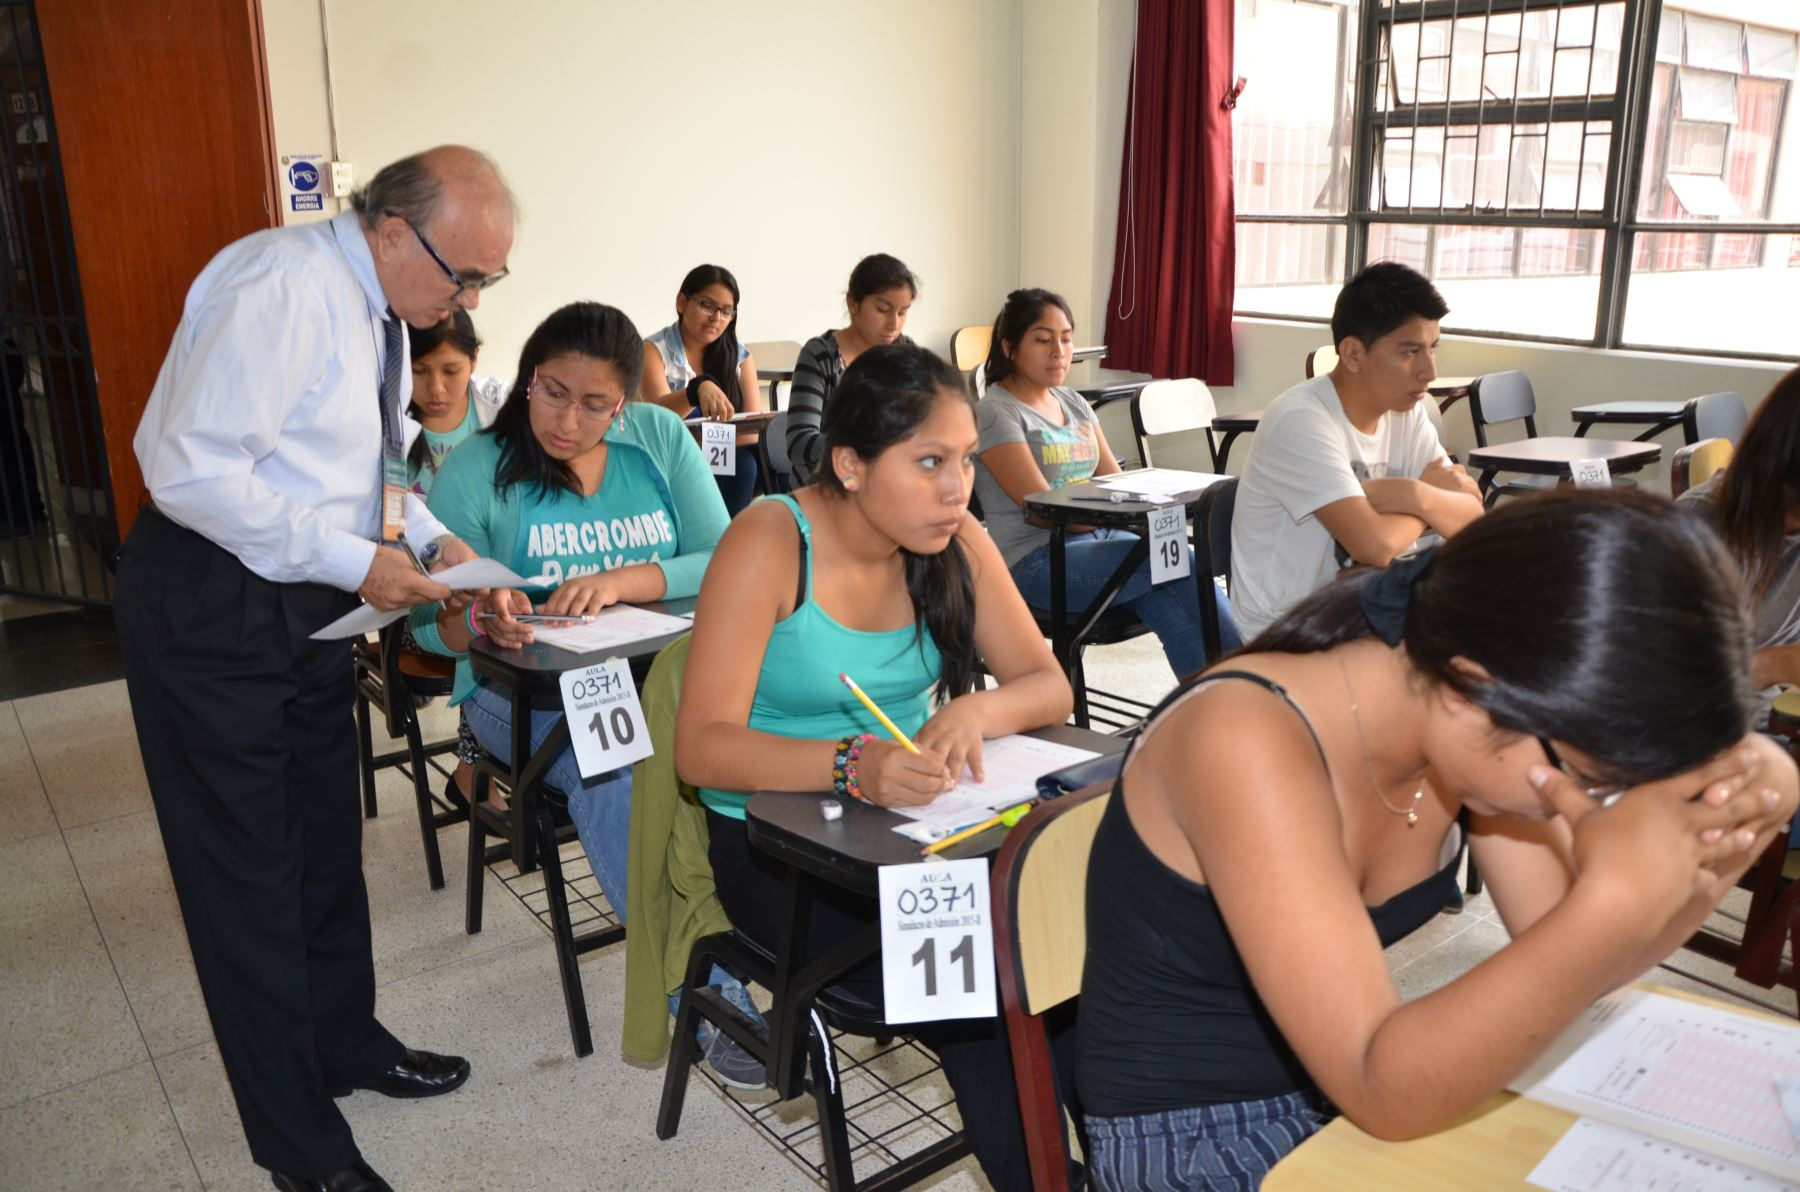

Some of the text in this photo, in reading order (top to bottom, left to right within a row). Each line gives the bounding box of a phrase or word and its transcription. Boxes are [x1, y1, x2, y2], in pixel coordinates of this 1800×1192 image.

[707, 429, 730, 440] 0371
[710, 446, 727, 467] 21
[527, 509, 673, 558] ABERCROMBIE
[1154, 514, 1180, 532] 0371
[1160, 539, 1180, 568] 19
[572, 671, 622, 700] 0371
[585, 666, 606, 677] AULA
[588, 706, 635, 751] 10
[897, 882, 975, 915] 0371
[911, 934, 976, 997] 11
